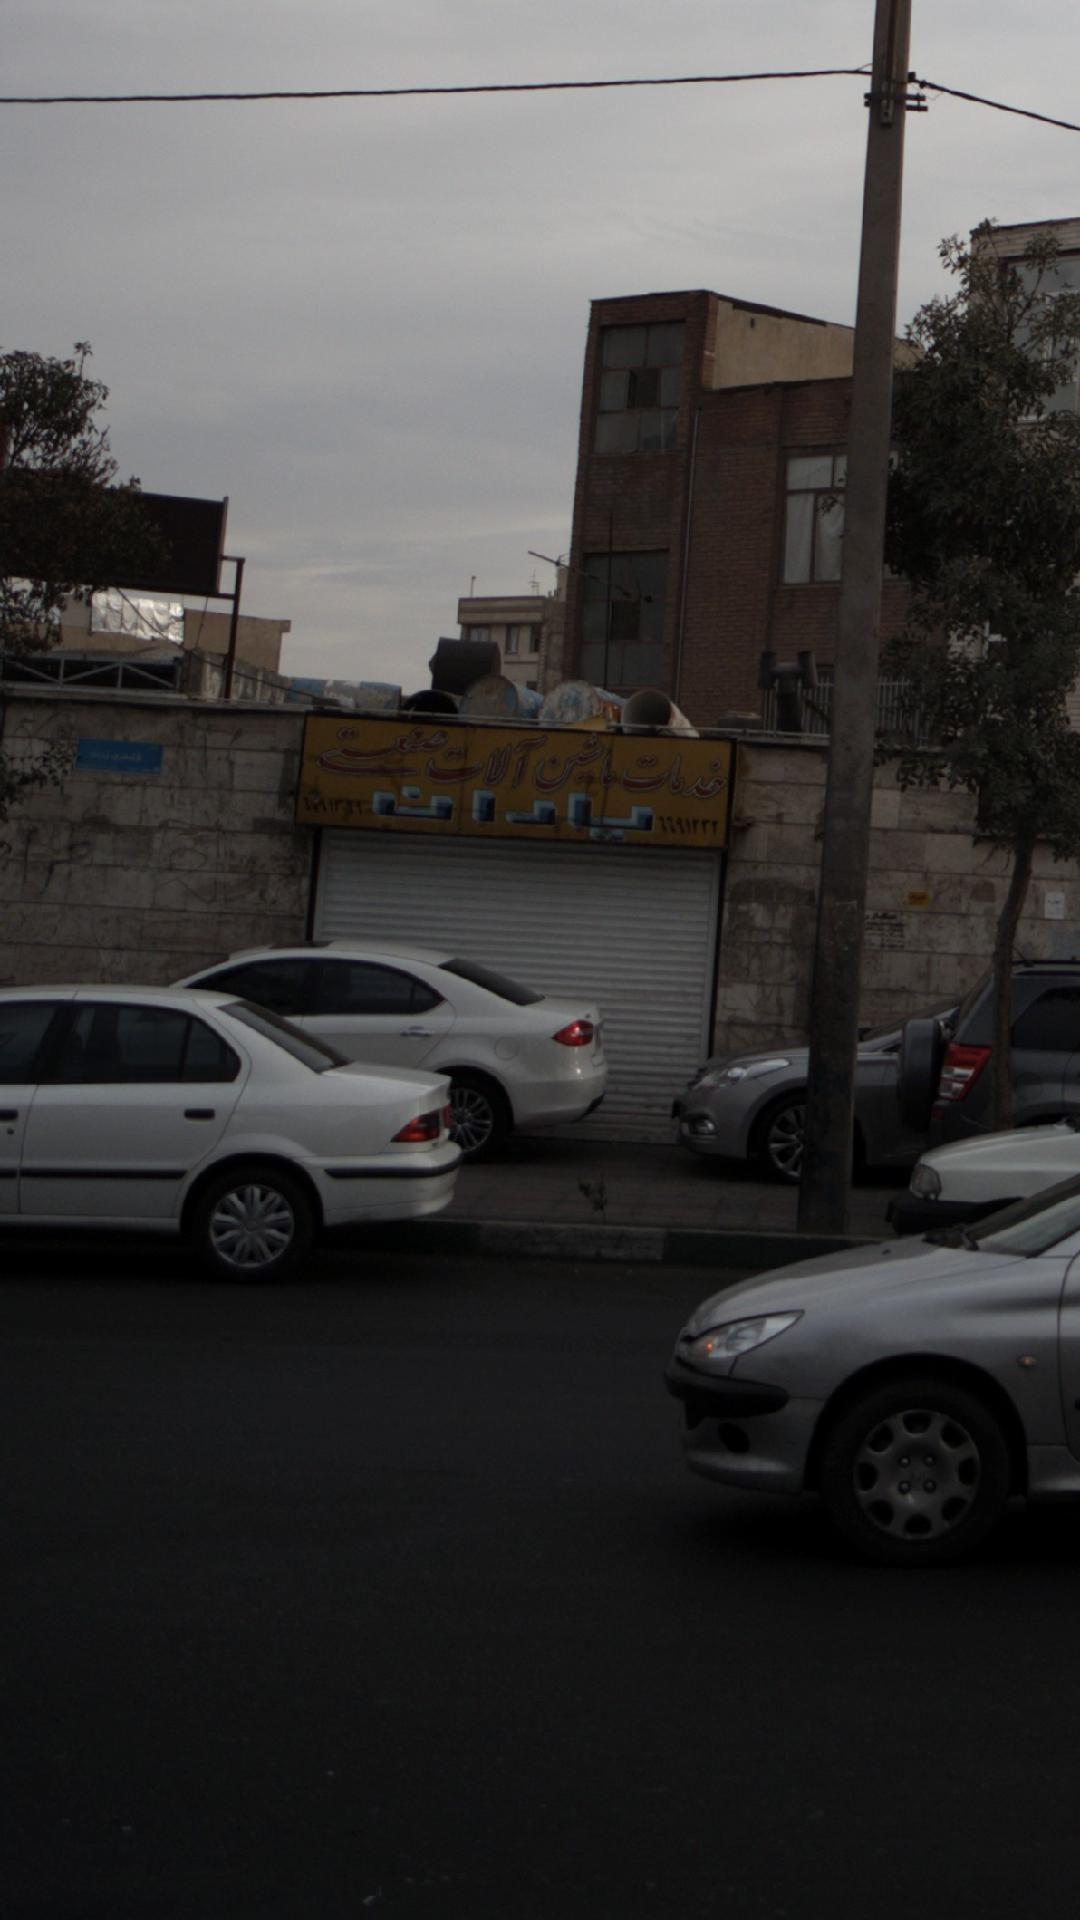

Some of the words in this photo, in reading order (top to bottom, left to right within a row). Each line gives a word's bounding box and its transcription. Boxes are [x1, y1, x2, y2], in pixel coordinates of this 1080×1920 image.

[426, 735, 548, 788] آلات
[534, 733, 618, 792] ماشین
[621, 753, 728, 798] خدمات
